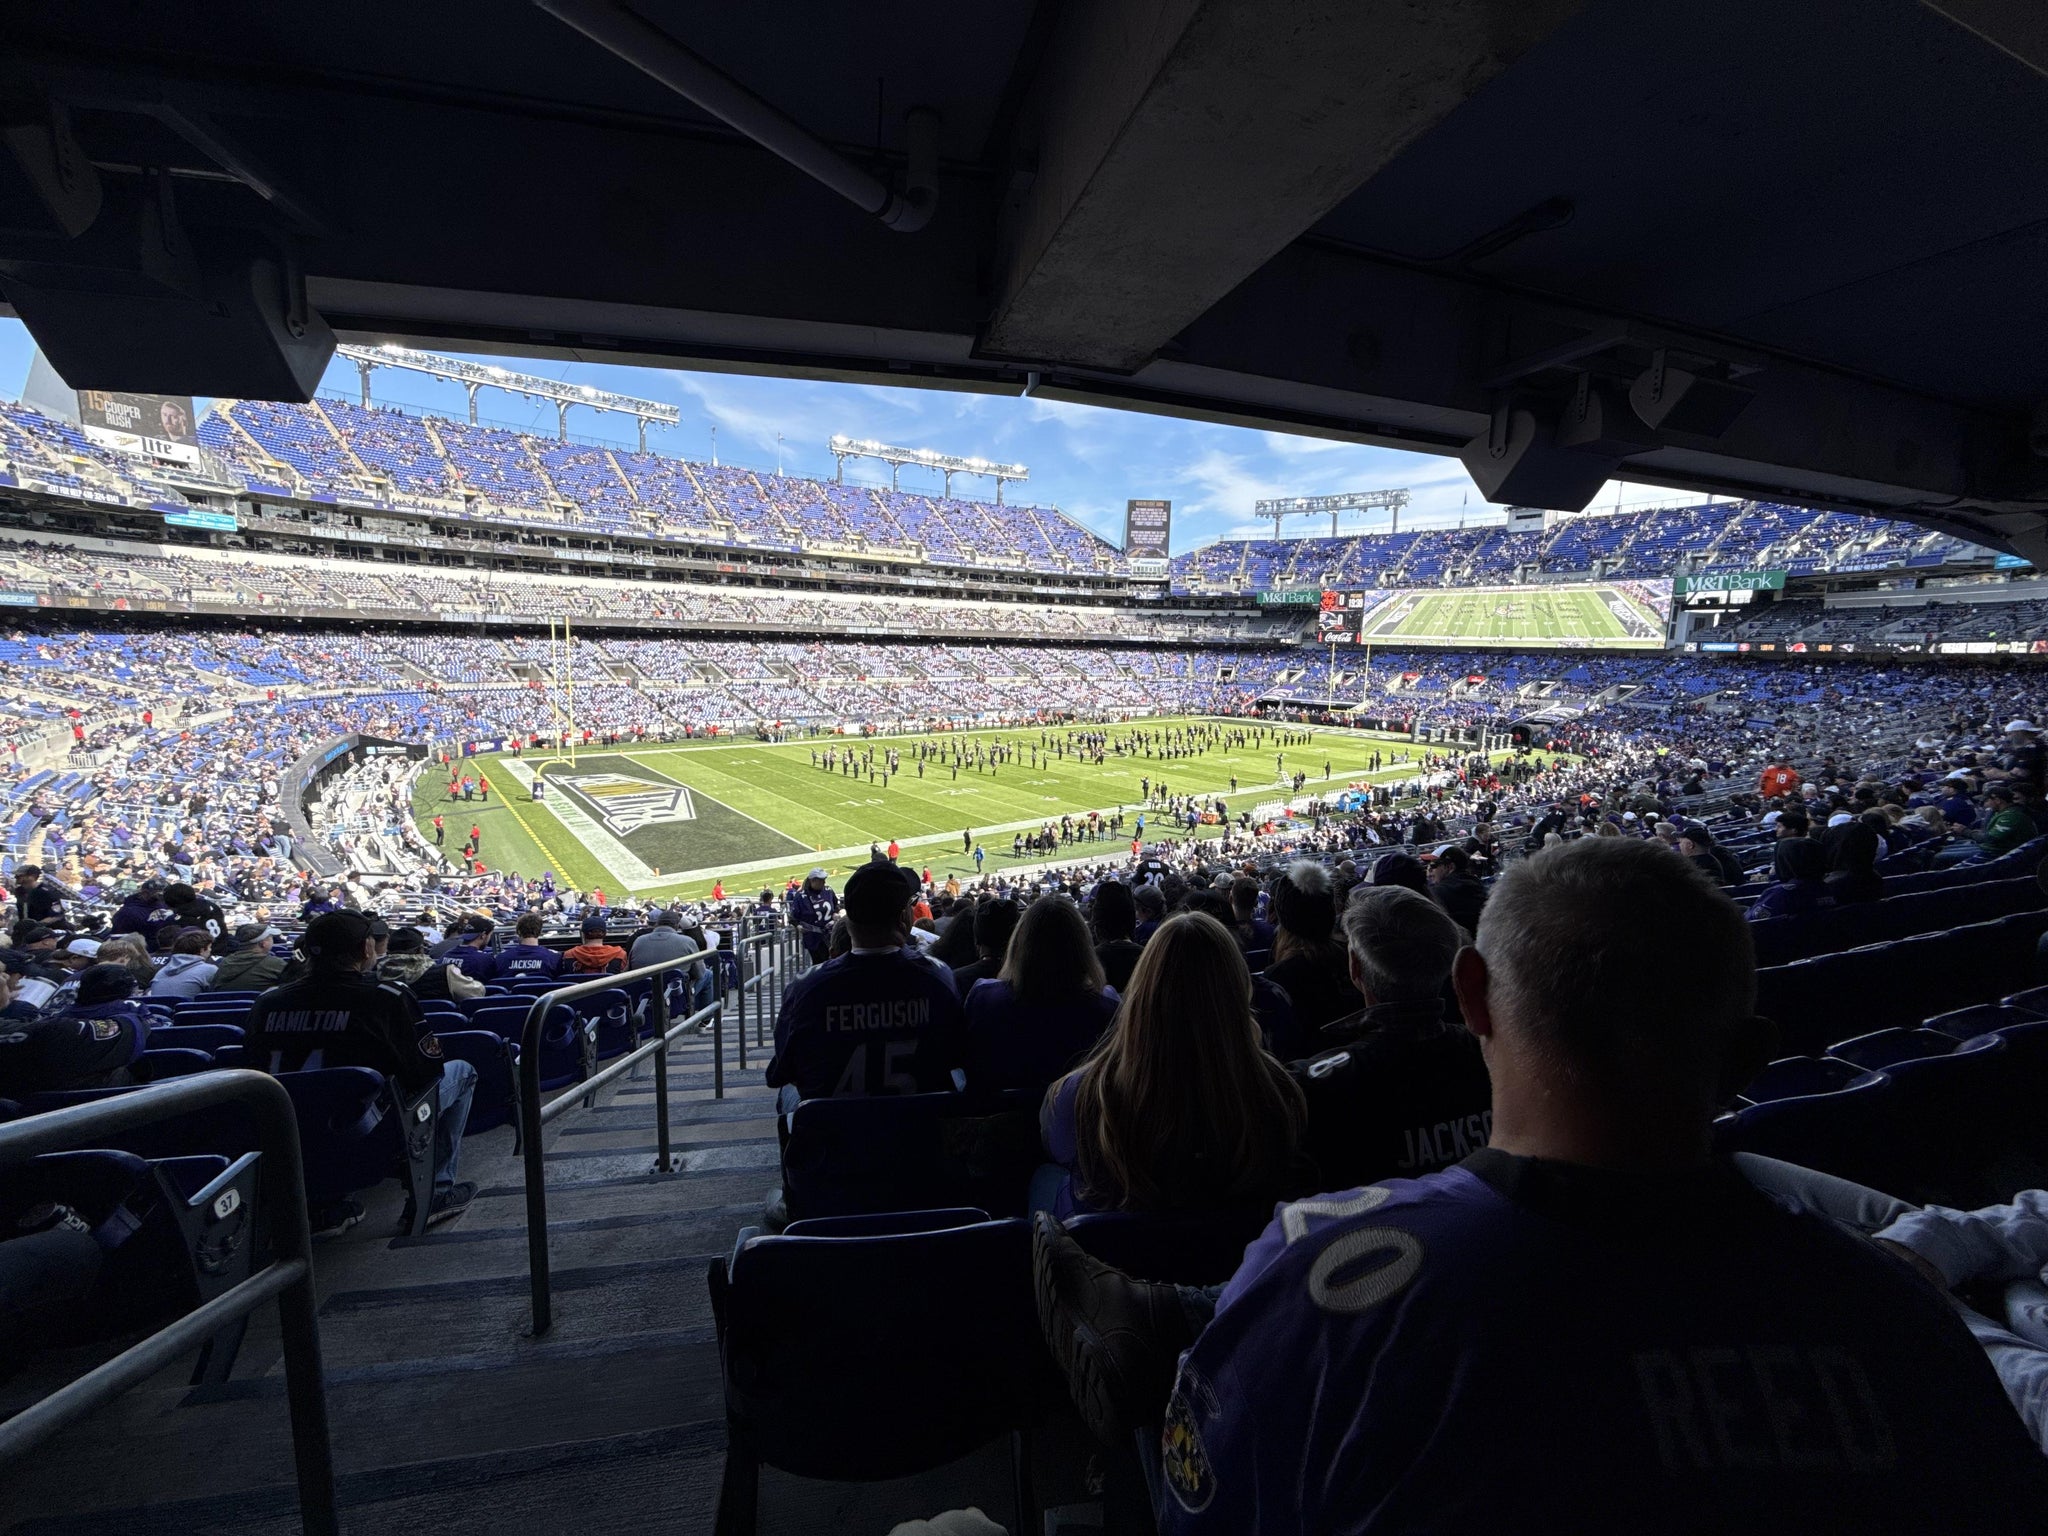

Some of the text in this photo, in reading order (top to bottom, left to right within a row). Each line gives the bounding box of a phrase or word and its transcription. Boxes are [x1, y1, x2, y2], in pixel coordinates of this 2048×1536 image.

[104, 400, 141, 419] COOPER
[106, 412, 132, 428] RUSH
[1684, 573, 1773, 592] M&T Bank
[1262, 592, 1314, 603] M&T Bank
[1338, 594, 1345, 606] 0
[1337, 614, 1343, 625] 0
[1776, 773, 1787, 784] 18
[205, 918, 221, 938] 8
[508, 959, 542, 969] JACKSON
[265, 1010, 351, 1033] HAMILTON
[825, 997, 930, 1033] FERGUSON
[831, 1040, 919, 1099] 45
[220, 1195, 234, 1213] 37
